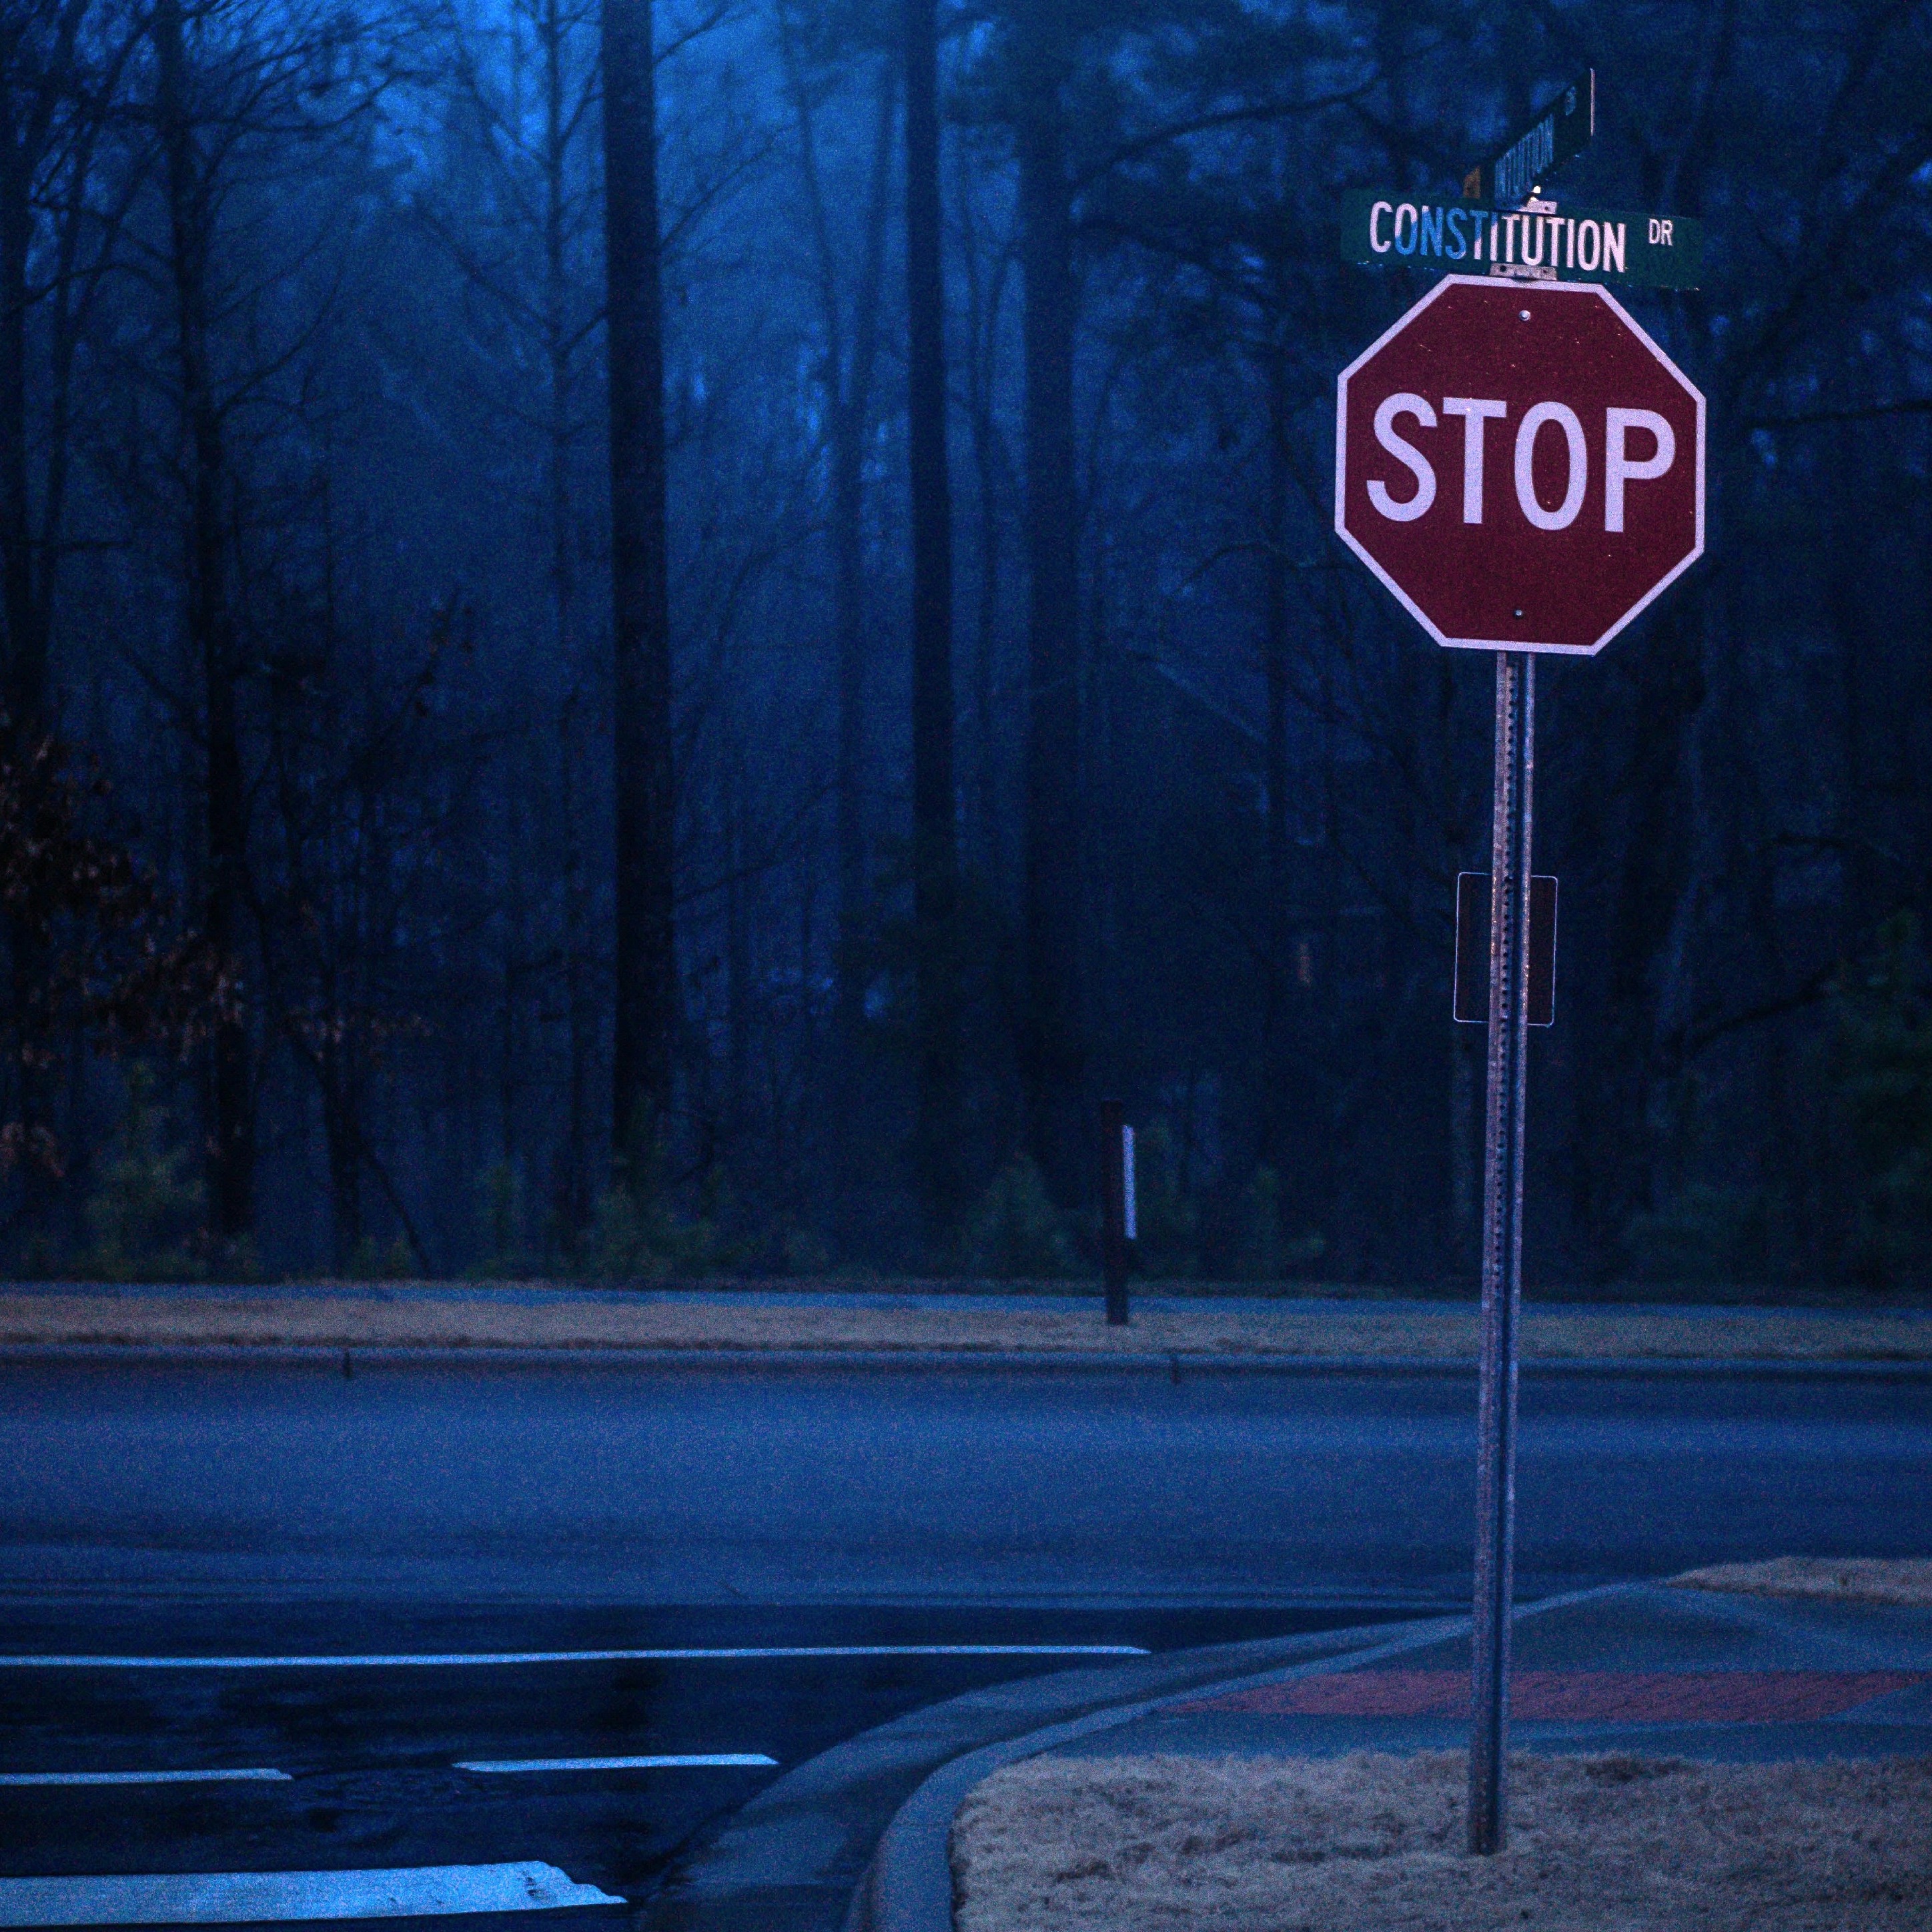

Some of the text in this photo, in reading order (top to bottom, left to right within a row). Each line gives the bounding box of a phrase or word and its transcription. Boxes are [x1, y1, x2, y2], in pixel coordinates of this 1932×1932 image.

[1370, 201, 1674, 273] CONSTITUTION DR
[1366, 392, 1676, 533] STOP
